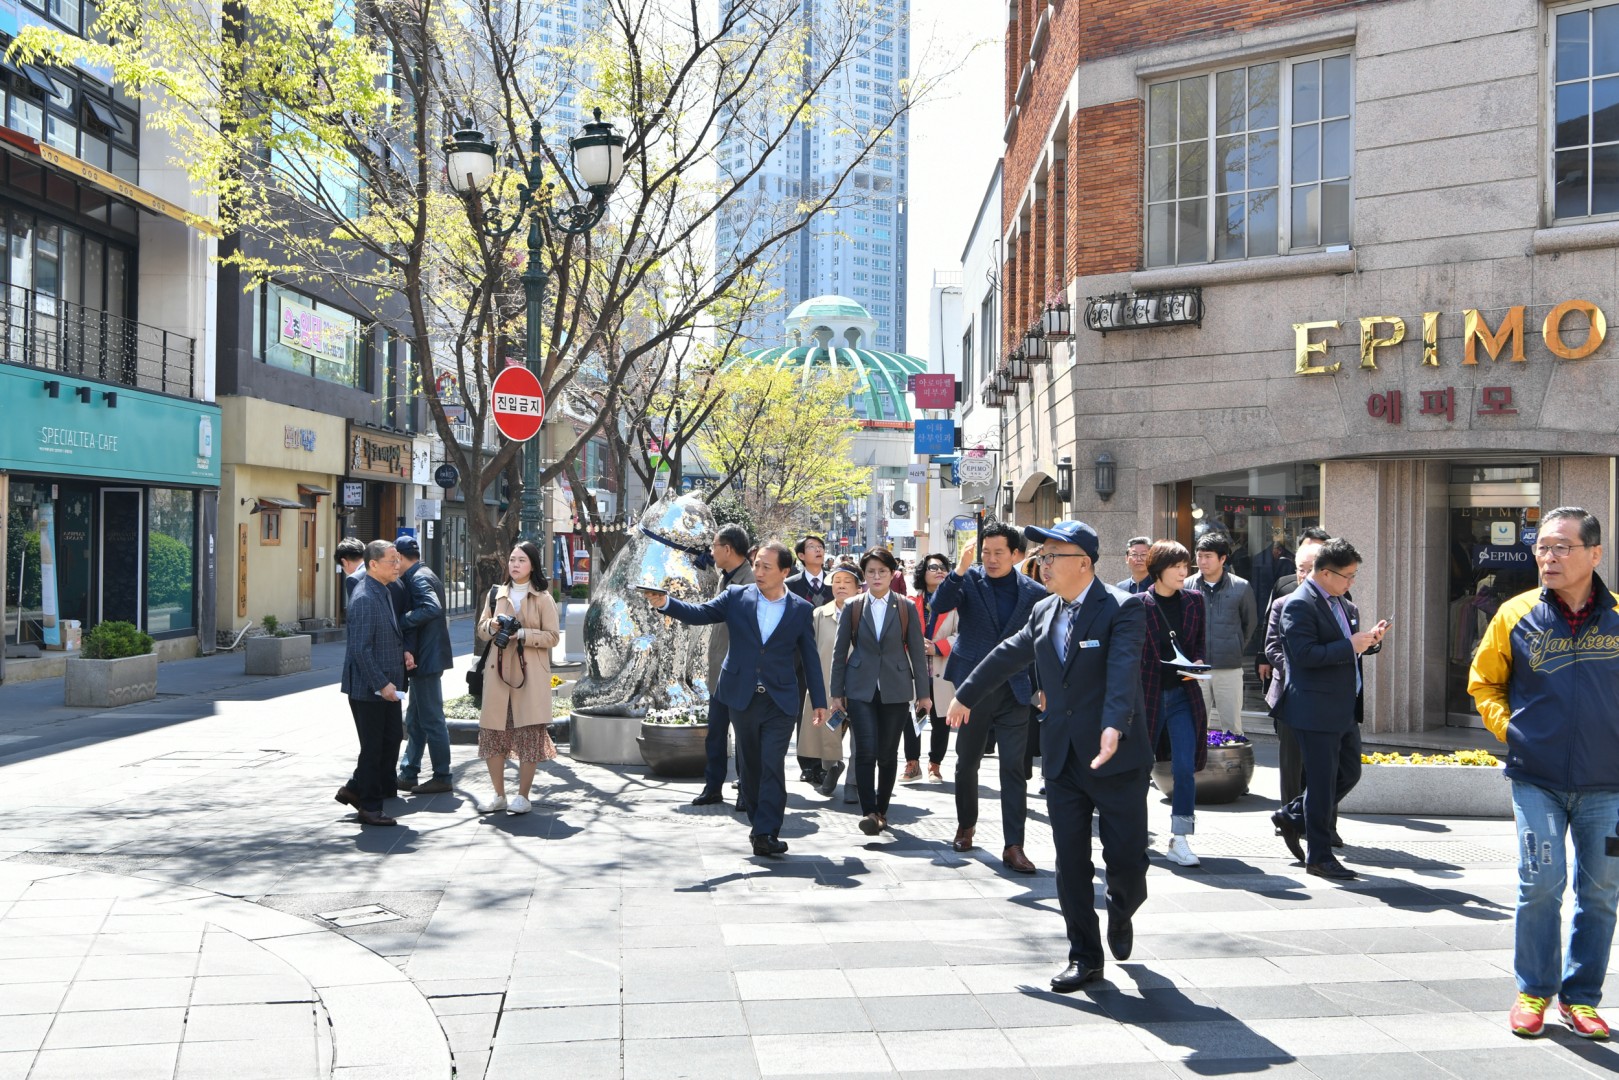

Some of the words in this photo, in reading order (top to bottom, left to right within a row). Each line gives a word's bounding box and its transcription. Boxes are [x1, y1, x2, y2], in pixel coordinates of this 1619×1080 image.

[1291, 299, 1608, 375] EPIMO
[497, 395, 539, 414] 진입금지
[1367, 386, 1520, 425] 에피모
[98, 432, 119, 452] CAFE
[1523, 532, 1537, 540] ADT
[1490, 551, 1528, 562] EPIMO
